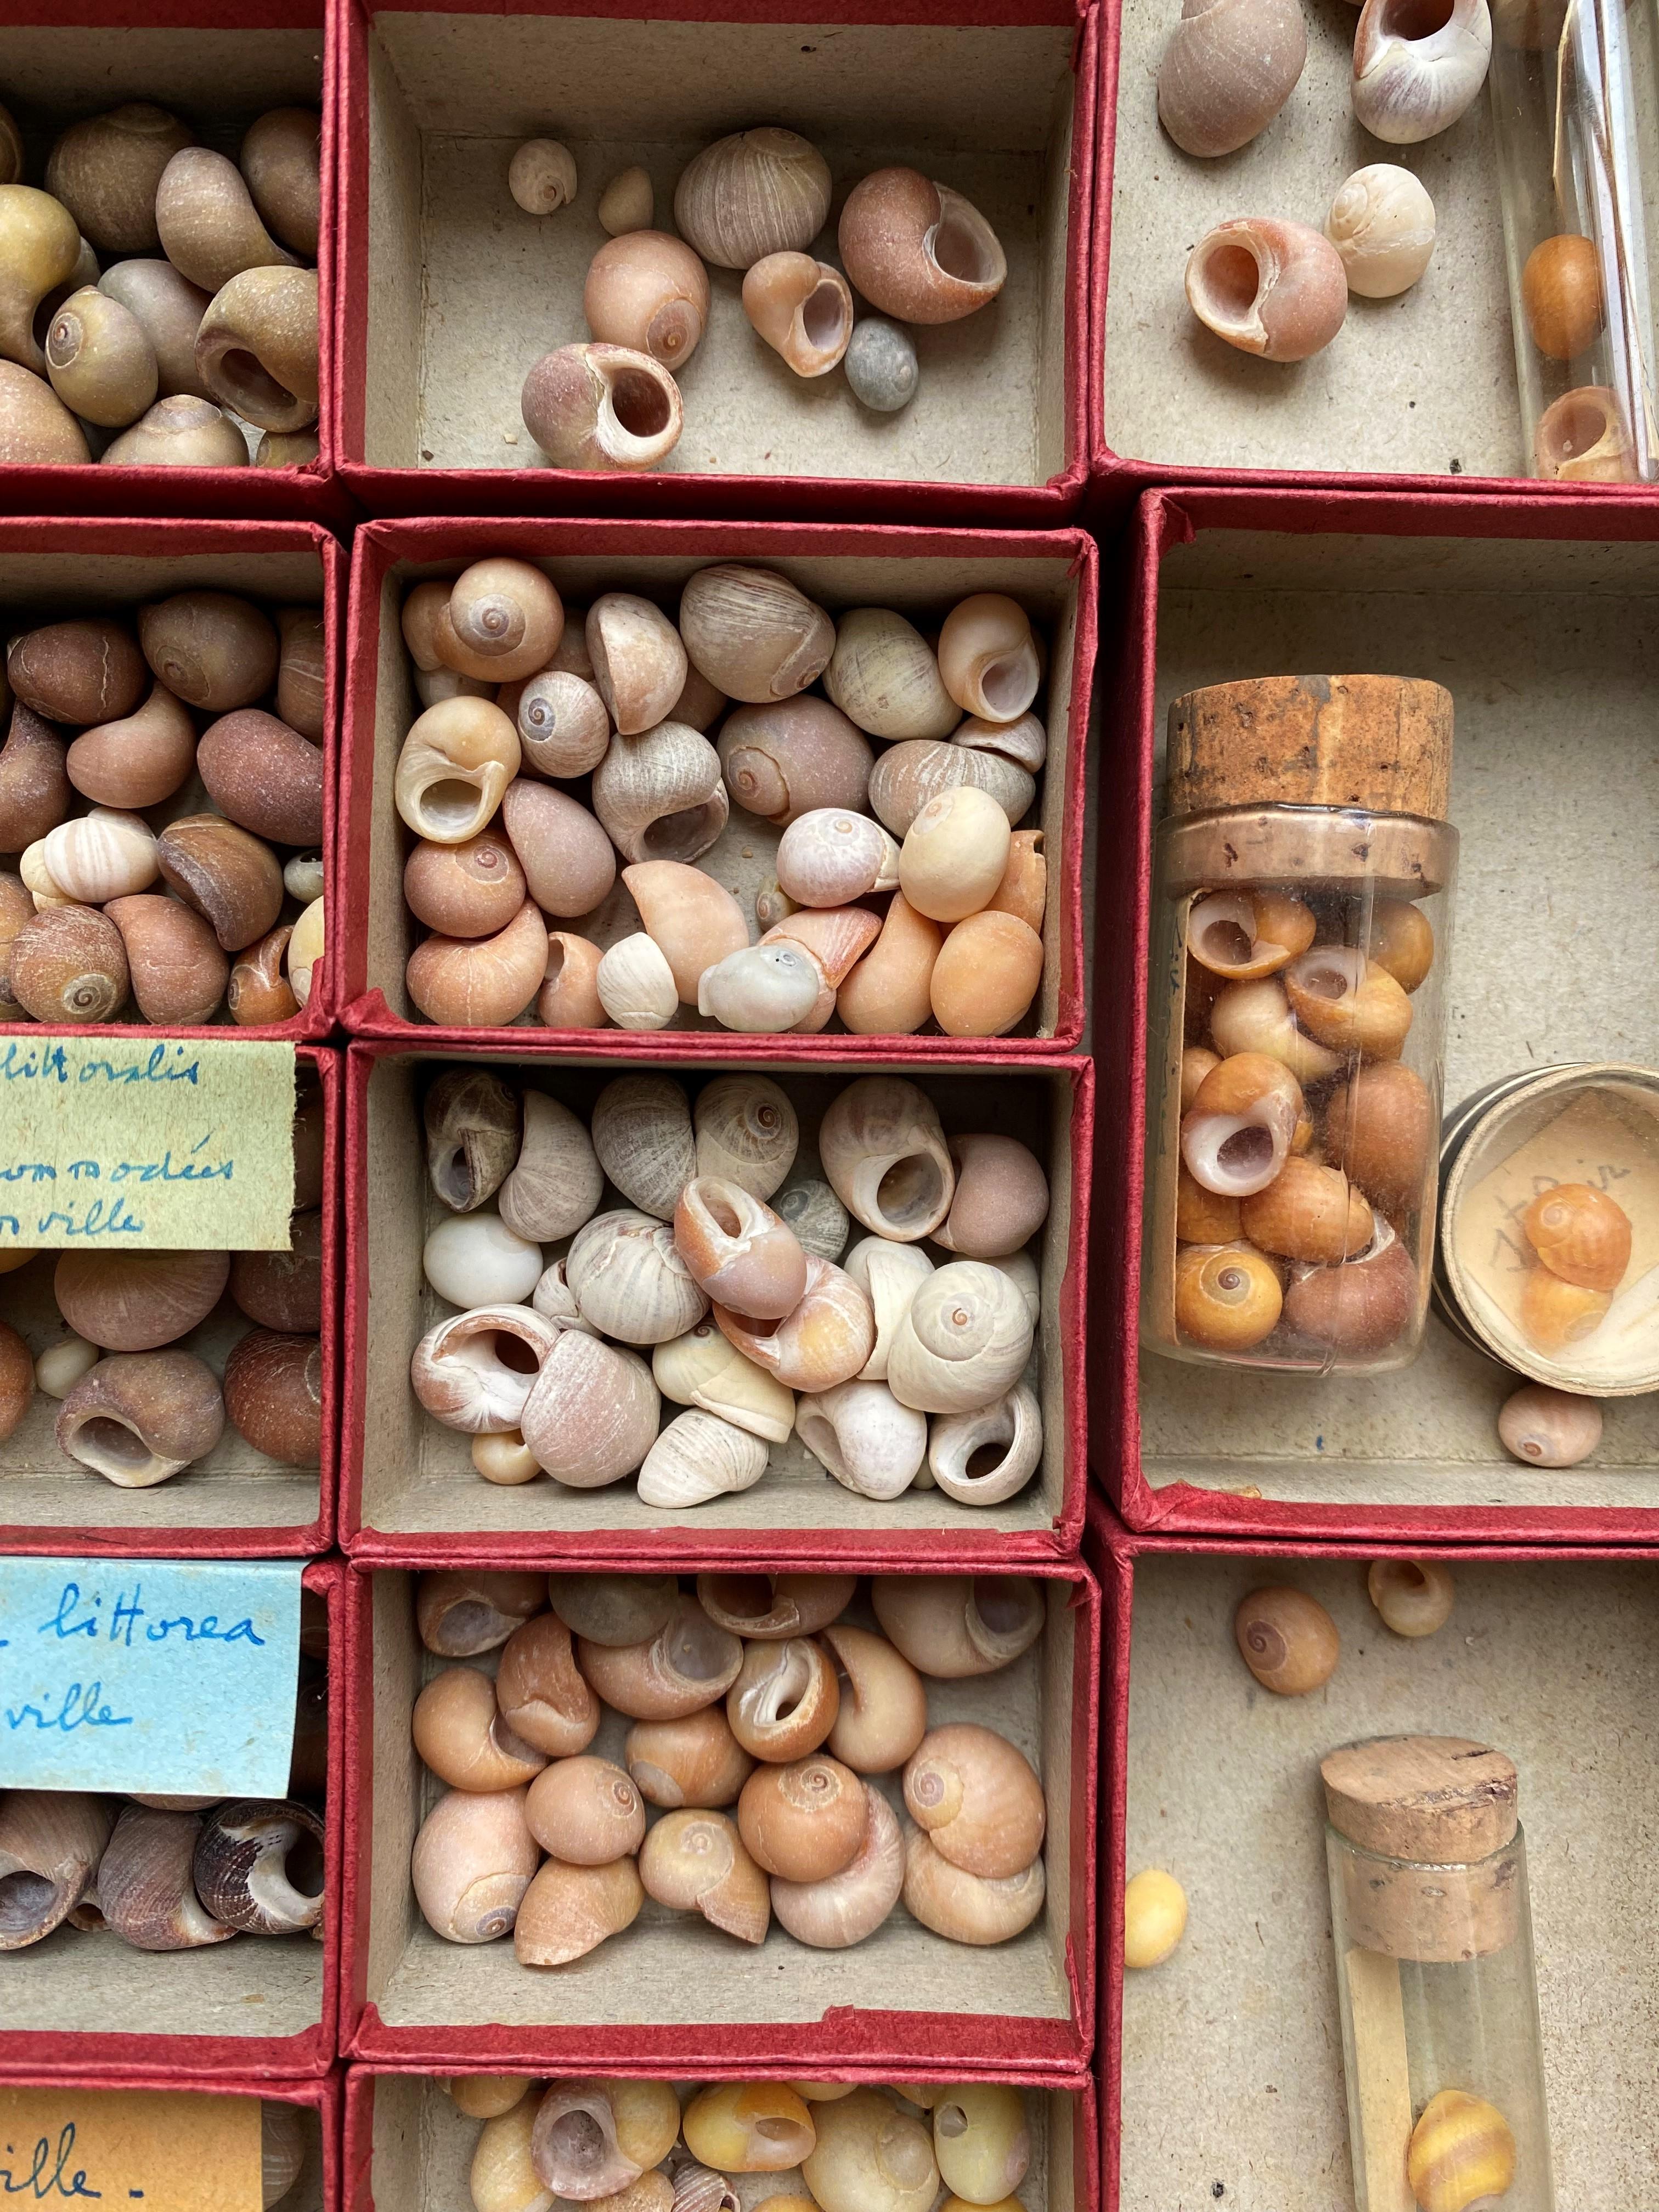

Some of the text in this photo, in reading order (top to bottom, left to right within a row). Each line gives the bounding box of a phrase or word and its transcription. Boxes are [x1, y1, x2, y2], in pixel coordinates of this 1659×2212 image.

[0, 1129, 234, 1182] ommodées
[38, 1582, 266, 1646] littorea
[0, 2121, 102, 2199] ille
